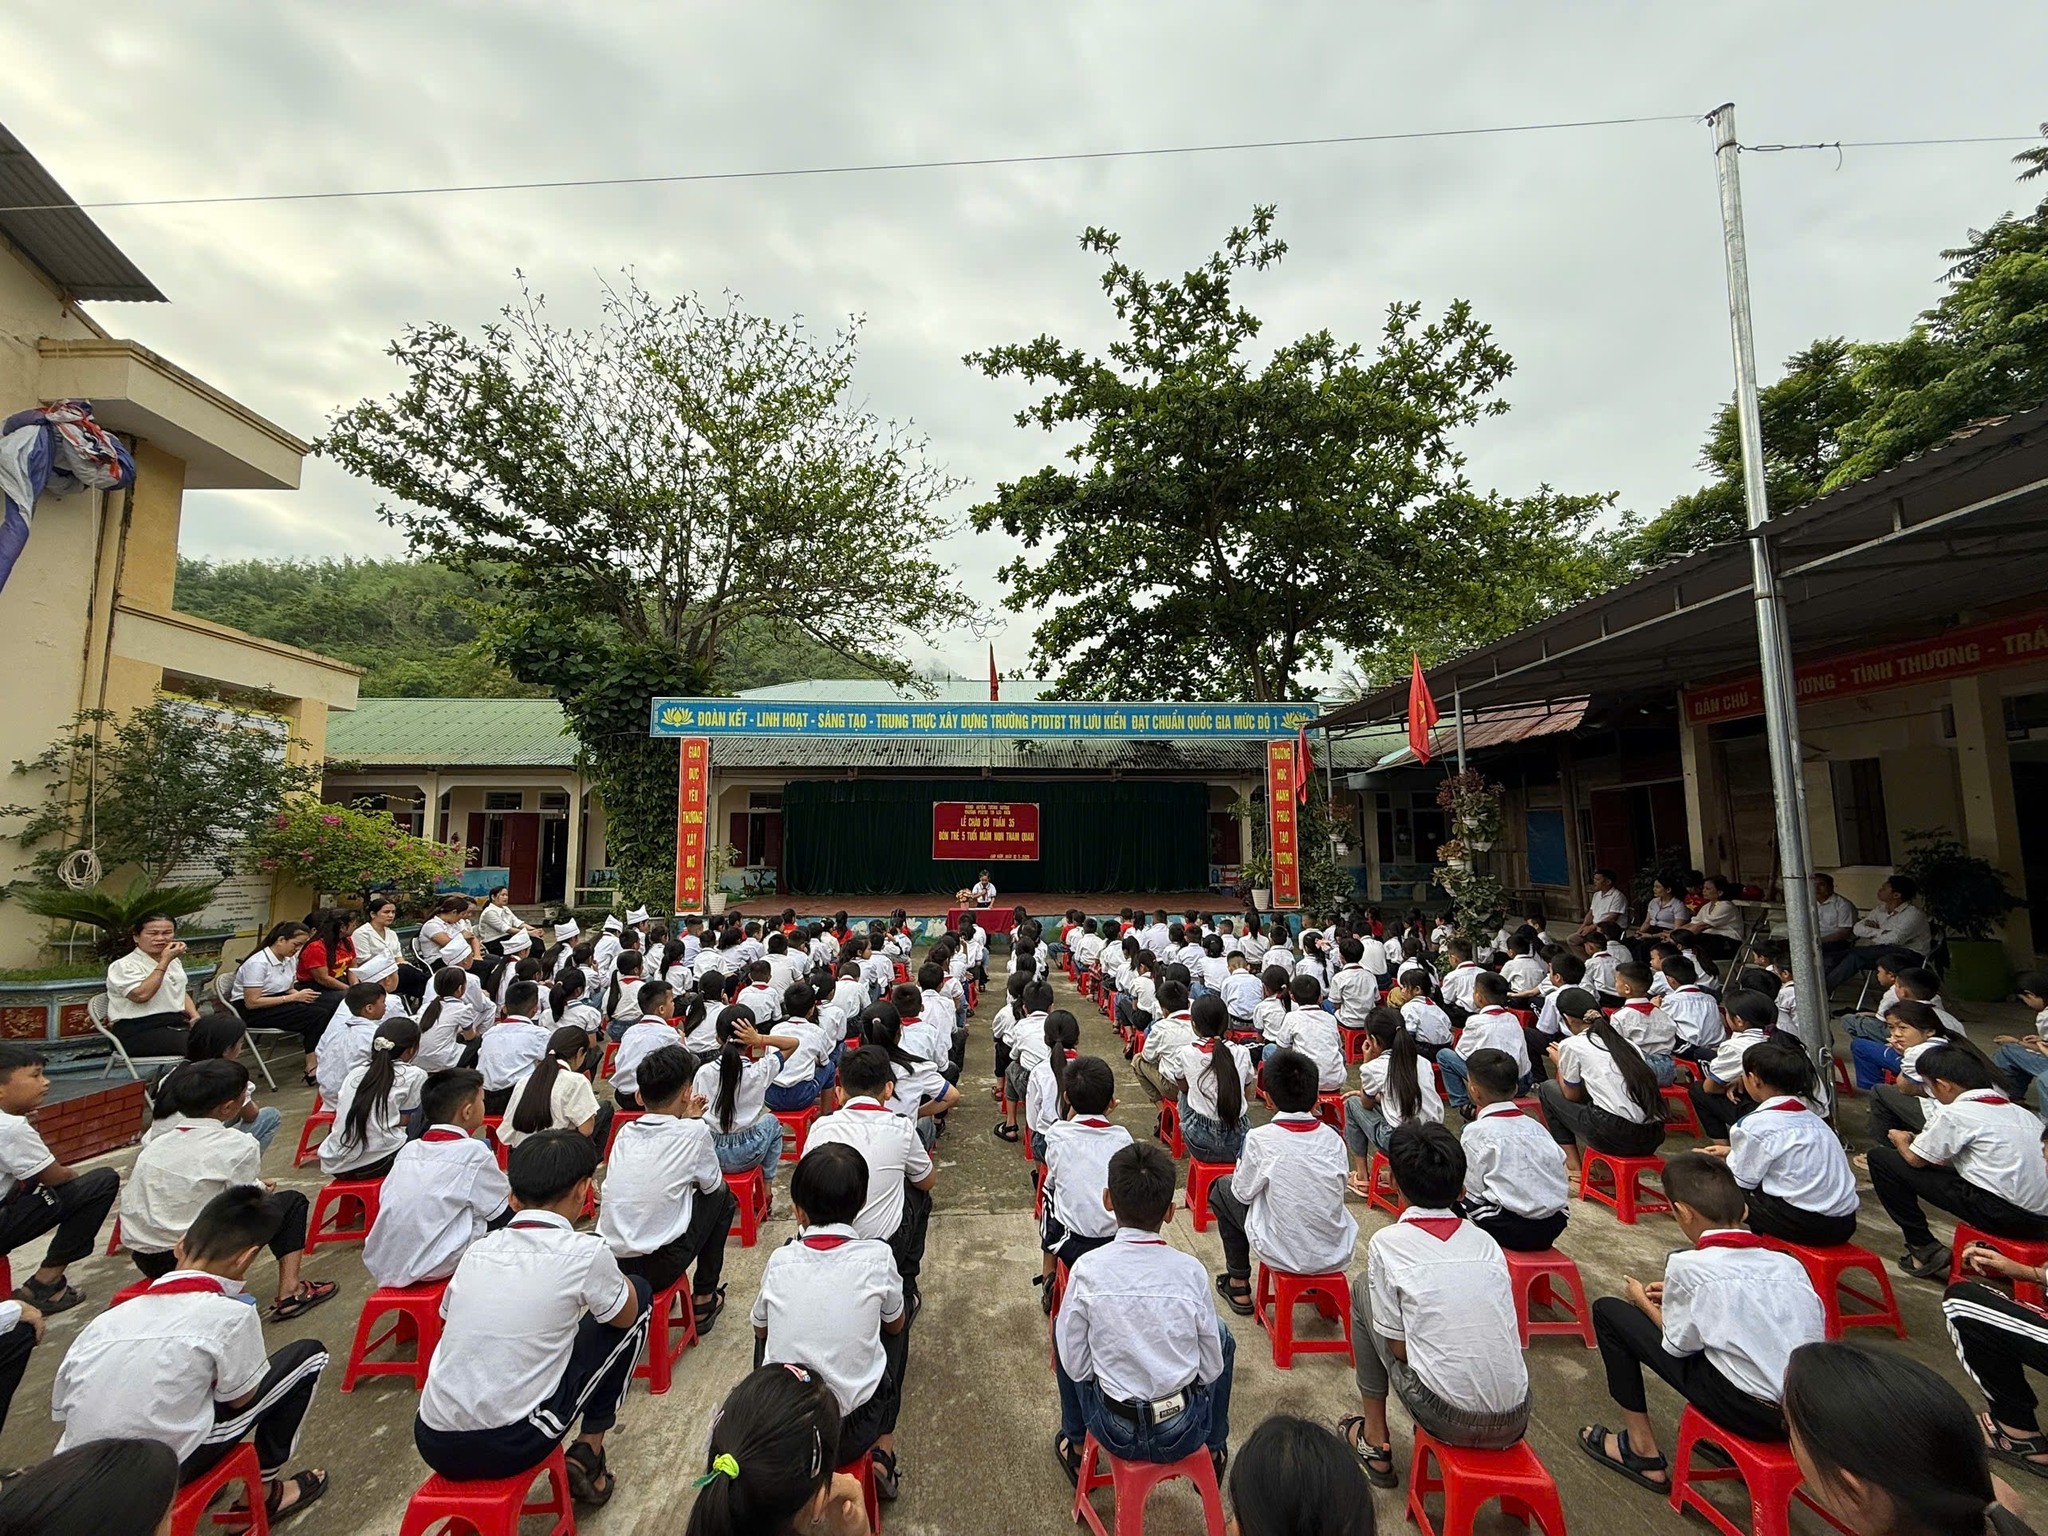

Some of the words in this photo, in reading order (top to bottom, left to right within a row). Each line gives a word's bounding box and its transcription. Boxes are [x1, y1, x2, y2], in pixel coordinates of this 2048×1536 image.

[1694, 697, 1720, 716] DÂN
[1722, 686, 1749, 711] CHỦ
[1795, 673, 1836, 696] ƯƠNG
[1850, 660, 1893, 685] TÌNH
[1896, 642, 1980, 676] THƯƠNG
[698, 708, 726, 727] ĐOÀN
[729, 707, 748, 727] KẾT
[756, 712, 778, 728] LINH
[782, 712, 809, 731] HOẠT
[818, 710, 846, 729] SÁNG
[848, 713, 867, 732] TẠO
[876, 713, 909, 729] TRUNG
[911, 712, 937, 732] THỰC
[939, 711, 958, 729] XÂY
[961, 712, 988, 732] DỰNG
[991, 711, 1029, 729] TRƯỜNG
[1031, 714, 1067, 730] PTDTBT
[1069, 714, 1080, 730] TH
[1083, 713, 1101, 730] LƯU
[1131, 714, 1150, 732] ĐẠT
[1152, 709, 1185, 730] CHUẨN
[1187, 710, 1213, 732] QUỐC
[1215, 714, 1231, 730] GIA
[1234, 711, 1255, 730] MỨC
[1257, 712, 1270, 733] ĐỘ
[1273, 715, 1277, 730] 1
[688, 743, 700, 758] GIÁO
[1008, 818, 1015, 828] 35
[961, 831, 966, 841] 5
